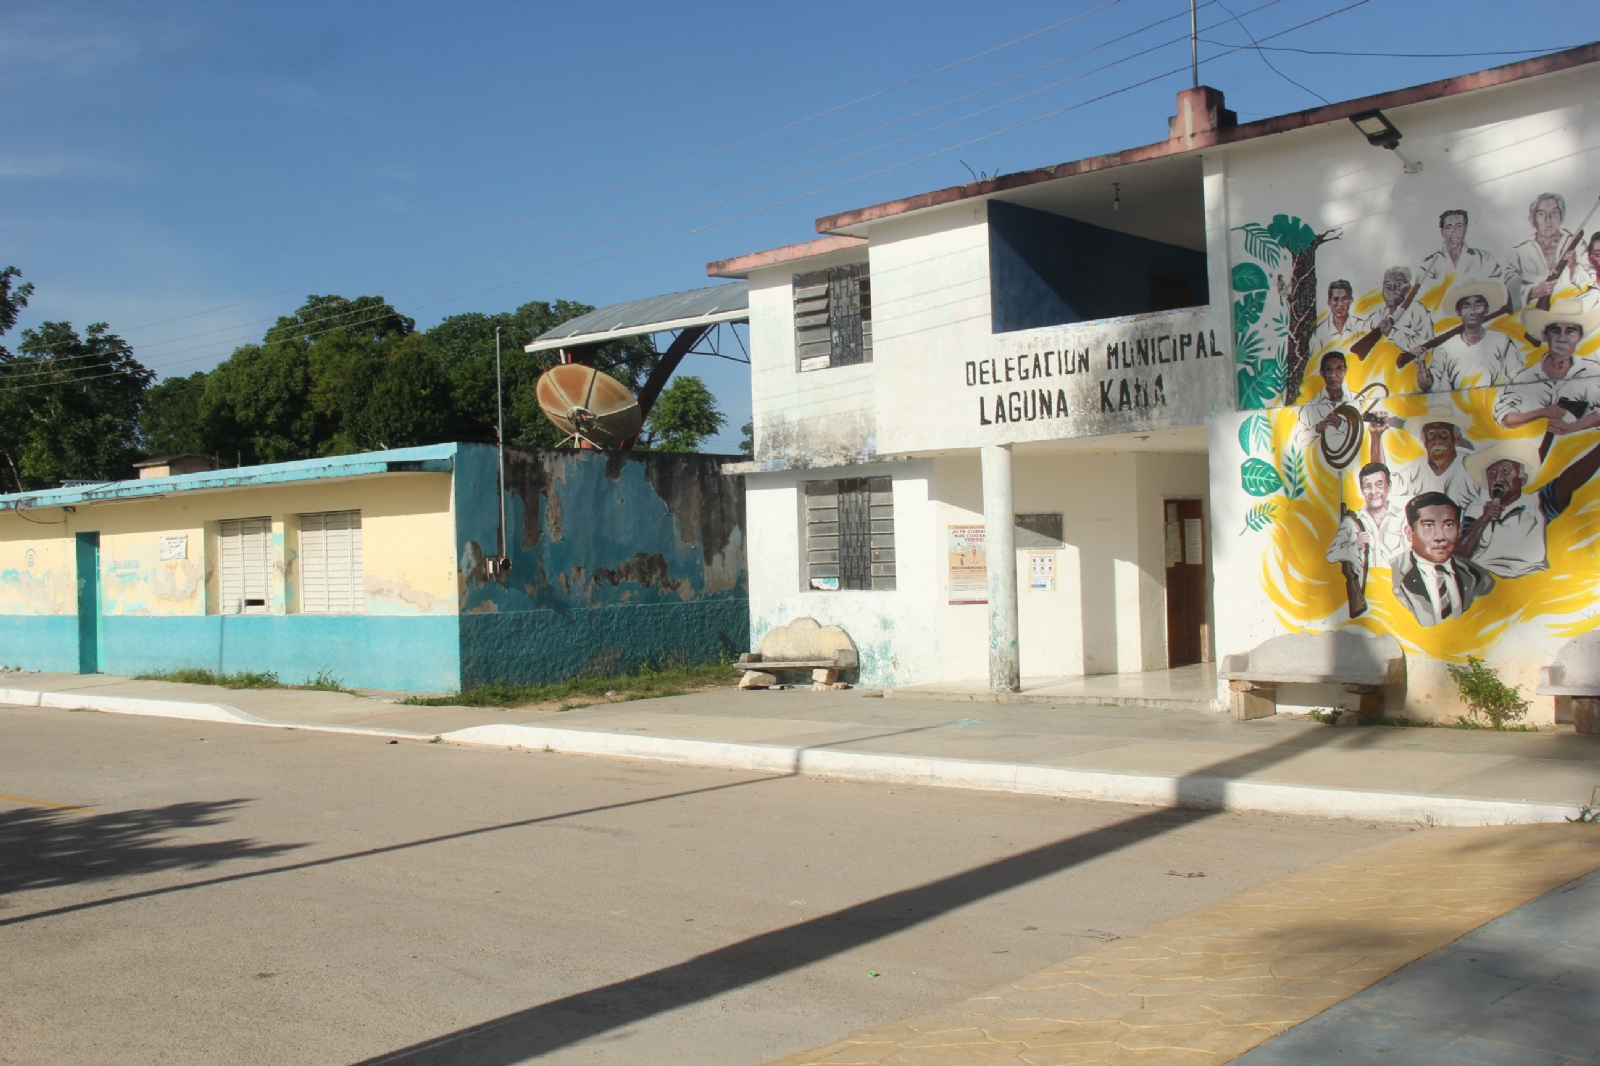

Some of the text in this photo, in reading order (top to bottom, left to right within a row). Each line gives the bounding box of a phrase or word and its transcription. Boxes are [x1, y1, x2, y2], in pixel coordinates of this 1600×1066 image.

[965, 329, 1223, 386] DELEGACION MUNICIPAL
[980, 388, 1069, 425] LAGUNA
